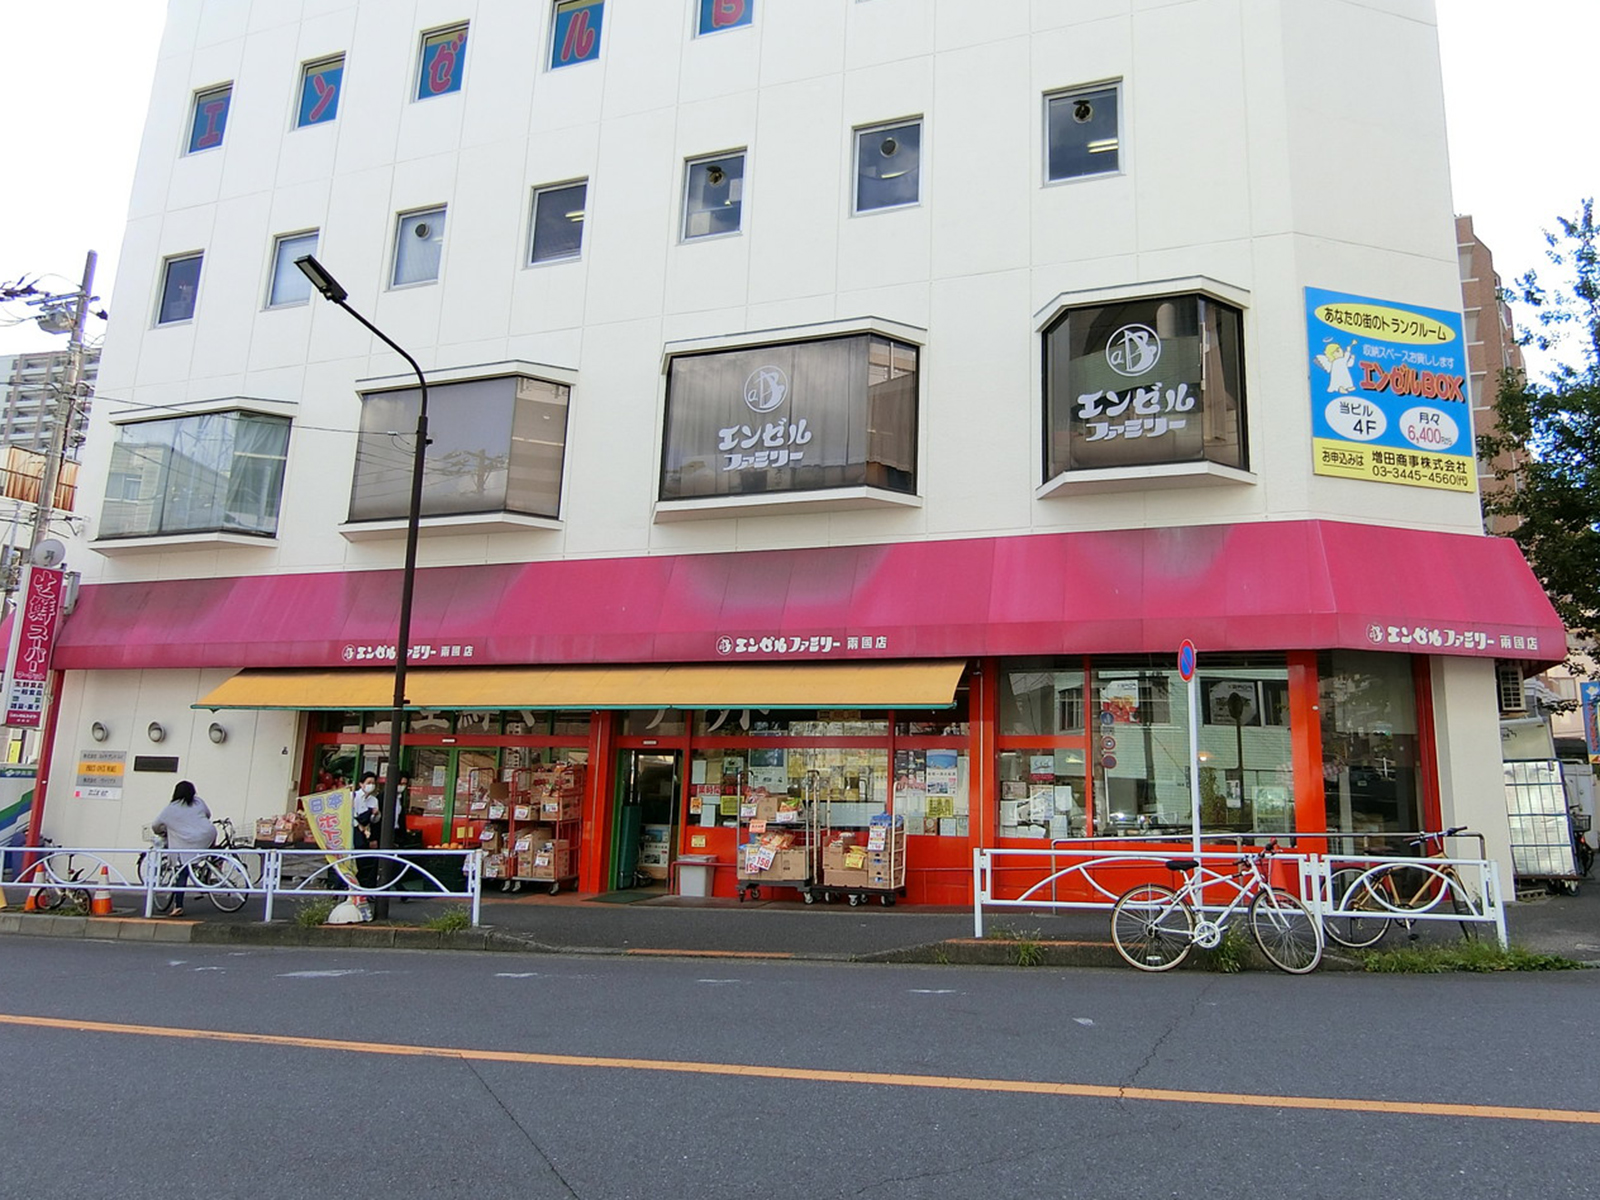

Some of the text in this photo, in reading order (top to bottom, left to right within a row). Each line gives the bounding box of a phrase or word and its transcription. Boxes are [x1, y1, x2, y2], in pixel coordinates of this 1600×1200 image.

[309, 73, 336, 122] ン
[561, 9, 596, 62] ル
[1324, 307, 1447, 341] あなたの街のトランクルーム
[1359, 361, 1466, 403] エンゼルBOX
[1077, 381, 1195, 419] エンゼル
[1340, 401, 1373, 417] 当ビル
[1085, 417, 1187, 442] ファミリー
[1353, 418, 1376, 435] 4F
[1419, 412, 1440, 426] 月々
[718, 417, 812, 451] エンゼル
[723, 449, 804, 471] ファミリー
[1322, 450, 1364, 467] お申込みは
[1371, 450, 1467, 474] 増田商事株式会社
[734, 635, 887, 654] エンゼルファミリー 両国店
[1386, 625, 1495, 650] エンゼルファミリー
